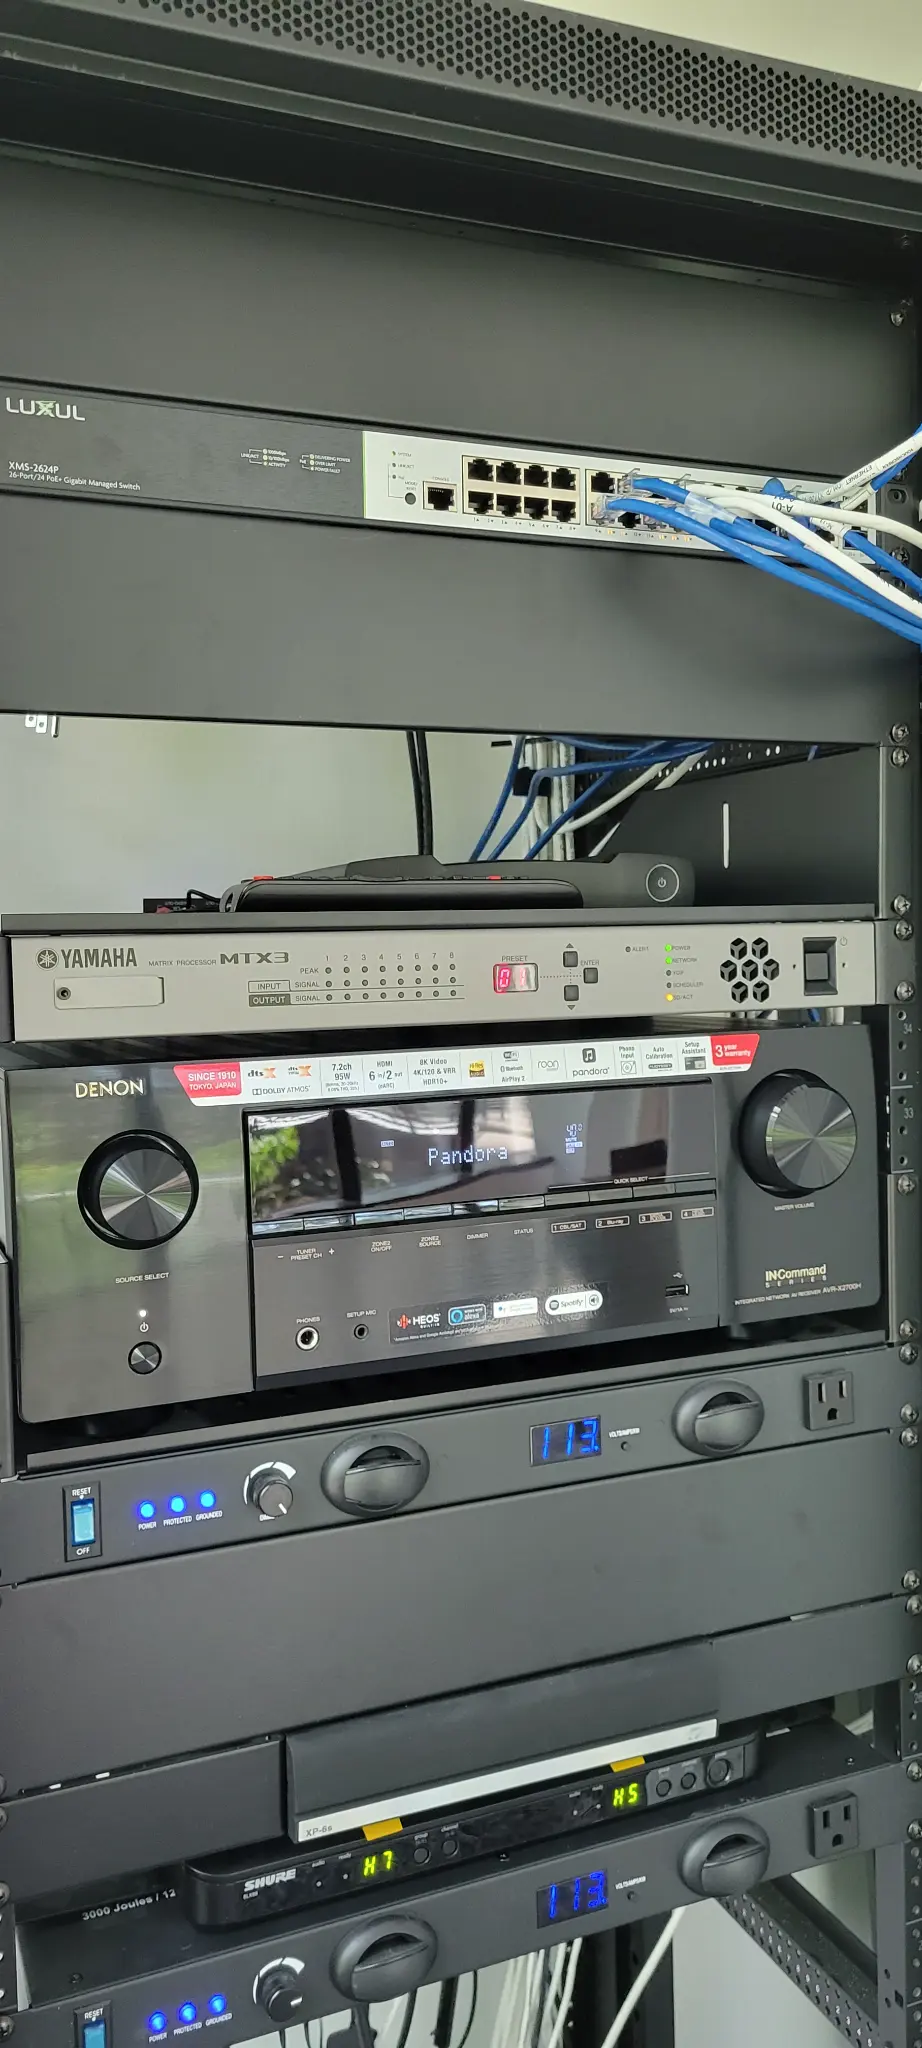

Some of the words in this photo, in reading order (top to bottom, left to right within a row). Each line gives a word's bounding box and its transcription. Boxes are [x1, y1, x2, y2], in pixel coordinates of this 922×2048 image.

[6, 397, 86, 421] LUXUL
[9, 461, 59, 474] XMS-2624P
[845, 465, 872, 485] ETHERNET
[9, 471, 45, 481] 26-Port/24
[64, 477, 87, 485] Gigabit
[88, 480, 117, 489] Managed
[118, 482, 140, 491] Switch
[61, 948, 138, 969] YAMAHA
[149, 959, 173, 967] MATRIX
[177, 959, 217, 967] PROCESSOR
[220, 952, 289, 966] MTX3
[499, 968, 527, 988] 01
[257, 982, 281, 991] INPUT
[252, 996, 286, 1005] OUTPUT
[903, 1023, 912, 1034] 34
[715, 1045, 723, 1057] 3
[724, 1050, 751, 1058] warranty
[332, 1063, 352, 1071] 7.2ch
[538, 1060, 559, 1068] roon
[188, 1073, 216, 1081] SINCE
[217, 1071, 236, 1080] 1910
[369, 1071, 375, 1081] 6
[413, 1067, 435, 1075] 4K/120
[572, 1067, 608, 1077] pandora
[189, 1083, 214, 1091] TOKYO,
[215, 1082, 236, 1090] JAPAN
[423, 1078, 448, 1086] HDR10+
[75, 1079, 145, 1098] DENON
[287, 1085, 309, 1093] ATMOS
[904, 1108, 914, 1119] 33
[428, 1146, 508, 1166] Pandora
[466, 1232, 488, 1240] DIMMER
[419, 1240, 441, 1248] SOURCE
[115, 1275, 143, 1284] SOURCE
[144, 1272, 169, 1281] SELECT
[561, 1299, 583, 1307] Spotify
[735, 1296, 765, 1305] INTEGRATED
[296, 1316, 320, 1324] PHONES
[413, 1314, 440, 1325] HEOS
[72, 1486, 92, 1496] RESET
[163, 1515, 193, 1526] PROTECTED
[196, 1510, 223, 1521] GROUNDED
[138, 1521, 157, 1531] POWER
[76, 1547, 90, 1555] OFF
[244, 1868, 297, 1892] SHURE
[82, 1906, 111, 1920] 3000
[113, 1896, 153, 1912] Joules
[162, 1888, 176, 1899] 12
[84, 2008, 104, 2020] RESET
[205, 2013, 233, 2027] GROUNDED
[173, 2022, 203, 2036] PROTECTED
[148, 2033, 168, 2043] POWER
